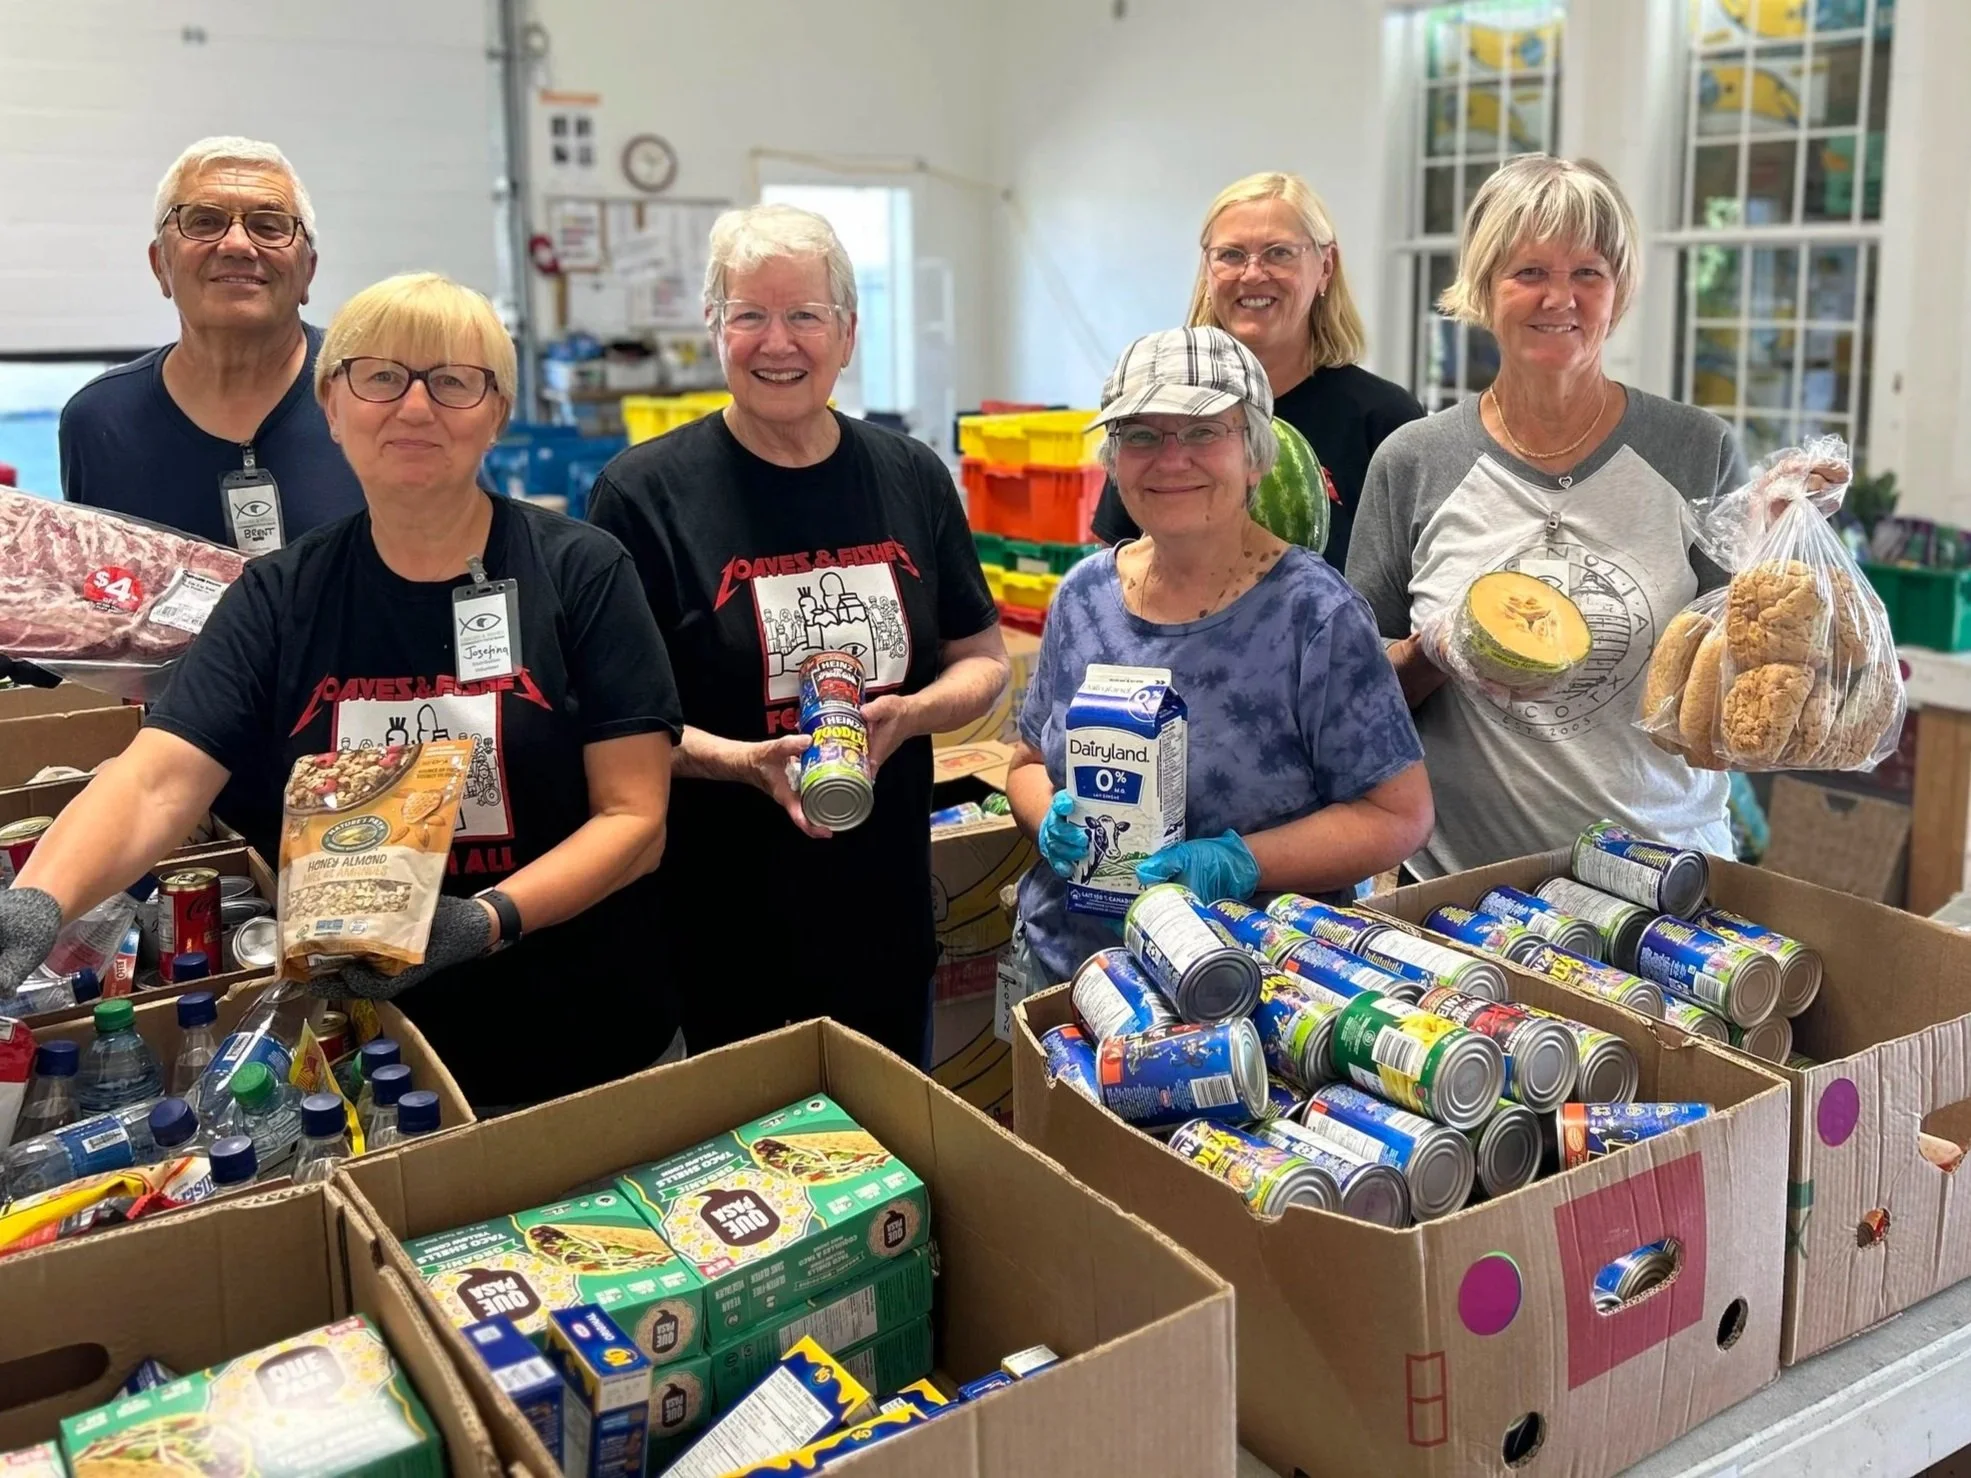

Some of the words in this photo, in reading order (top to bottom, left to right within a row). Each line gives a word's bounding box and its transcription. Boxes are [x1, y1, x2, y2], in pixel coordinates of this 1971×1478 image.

[814, 549, 835, 568] &
[822, 661, 854, 672] HEINZ
[766, 708, 798, 734] FO
[826, 716, 861, 729] HEINZ
[1070, 739, 1149, 763] Dairyland
[308, 857, 339, 873] HONEY
[342, 854, 387, 867] ALMOND
[464, 847, 517, 874] ALL
[1436, 994, 1466, 1019] EINZ
[685, 1151, 718, 1166] YELLOW
[702, 1152, 734, 1167] TACO
[656, 1165, 701, 1187] SHELLS
[677, 1166, 734, 1193] ORGANIC
[710, 1195, 758, 1222] PASA
[720, 1209, 770, 1239] QUE
[452, 1232, 490, 1245] YELLOW
[471, 1233, 506, 1247] TACO
[417, 1244, 468, 1264] SHELLS
[437, 1247, 504, 1271] ORGANIC
[468, 1276, 518, 1299] PASA
[477, 1290, 530, 1317] QUE
[585, 1312, 616, 1341] ORIGINAL
[656, 1321, 675, 1334] PASA
[656, 1331, 674, 1348] QUE
